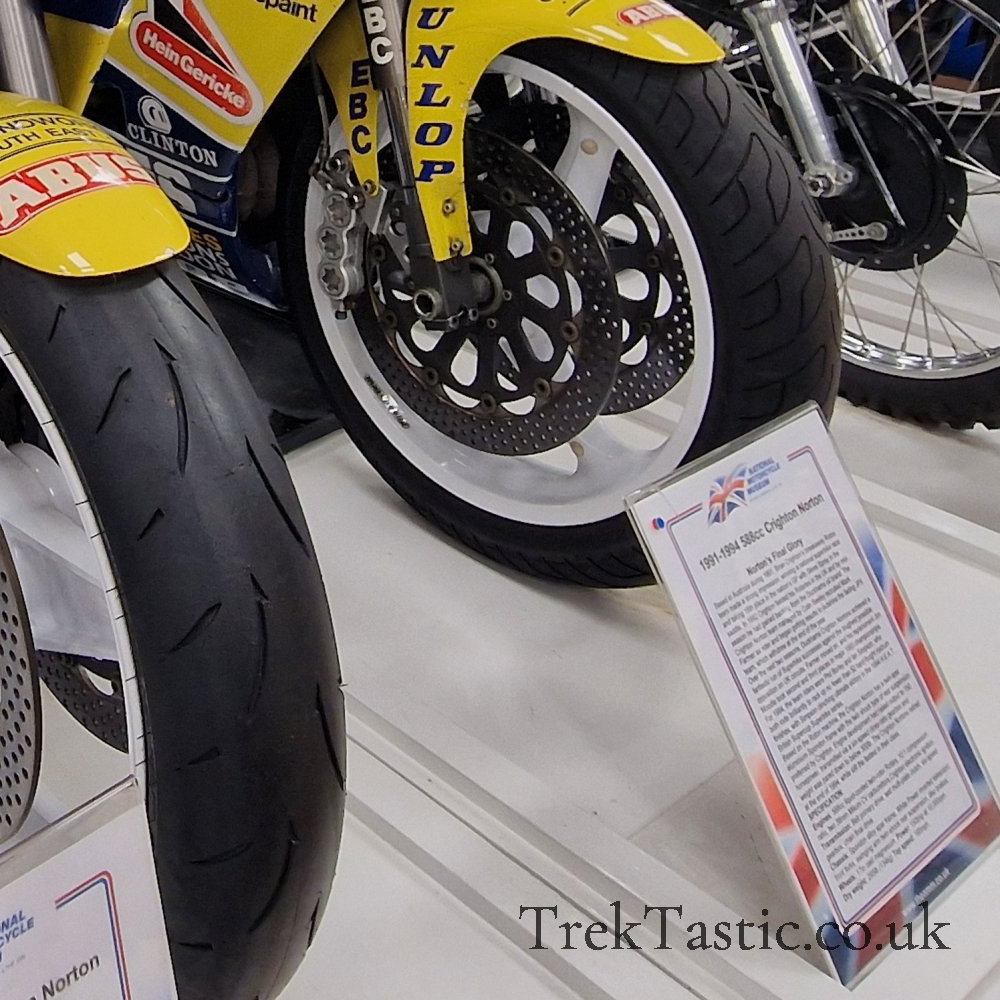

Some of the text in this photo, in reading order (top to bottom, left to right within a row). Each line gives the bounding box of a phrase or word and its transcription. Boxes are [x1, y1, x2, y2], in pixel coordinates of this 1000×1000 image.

[142, 29, 246, 110] HeinGericke
[350, 58, 372, 155] EBC
[127, 122, 218, 168] CLINTON
[699, 493, 825, 572] 1991-1994 588cc Crighton Norton
[746, 537, 805, 576] Norton's Final Glory
[41, 955, 101, 1000] Norton
